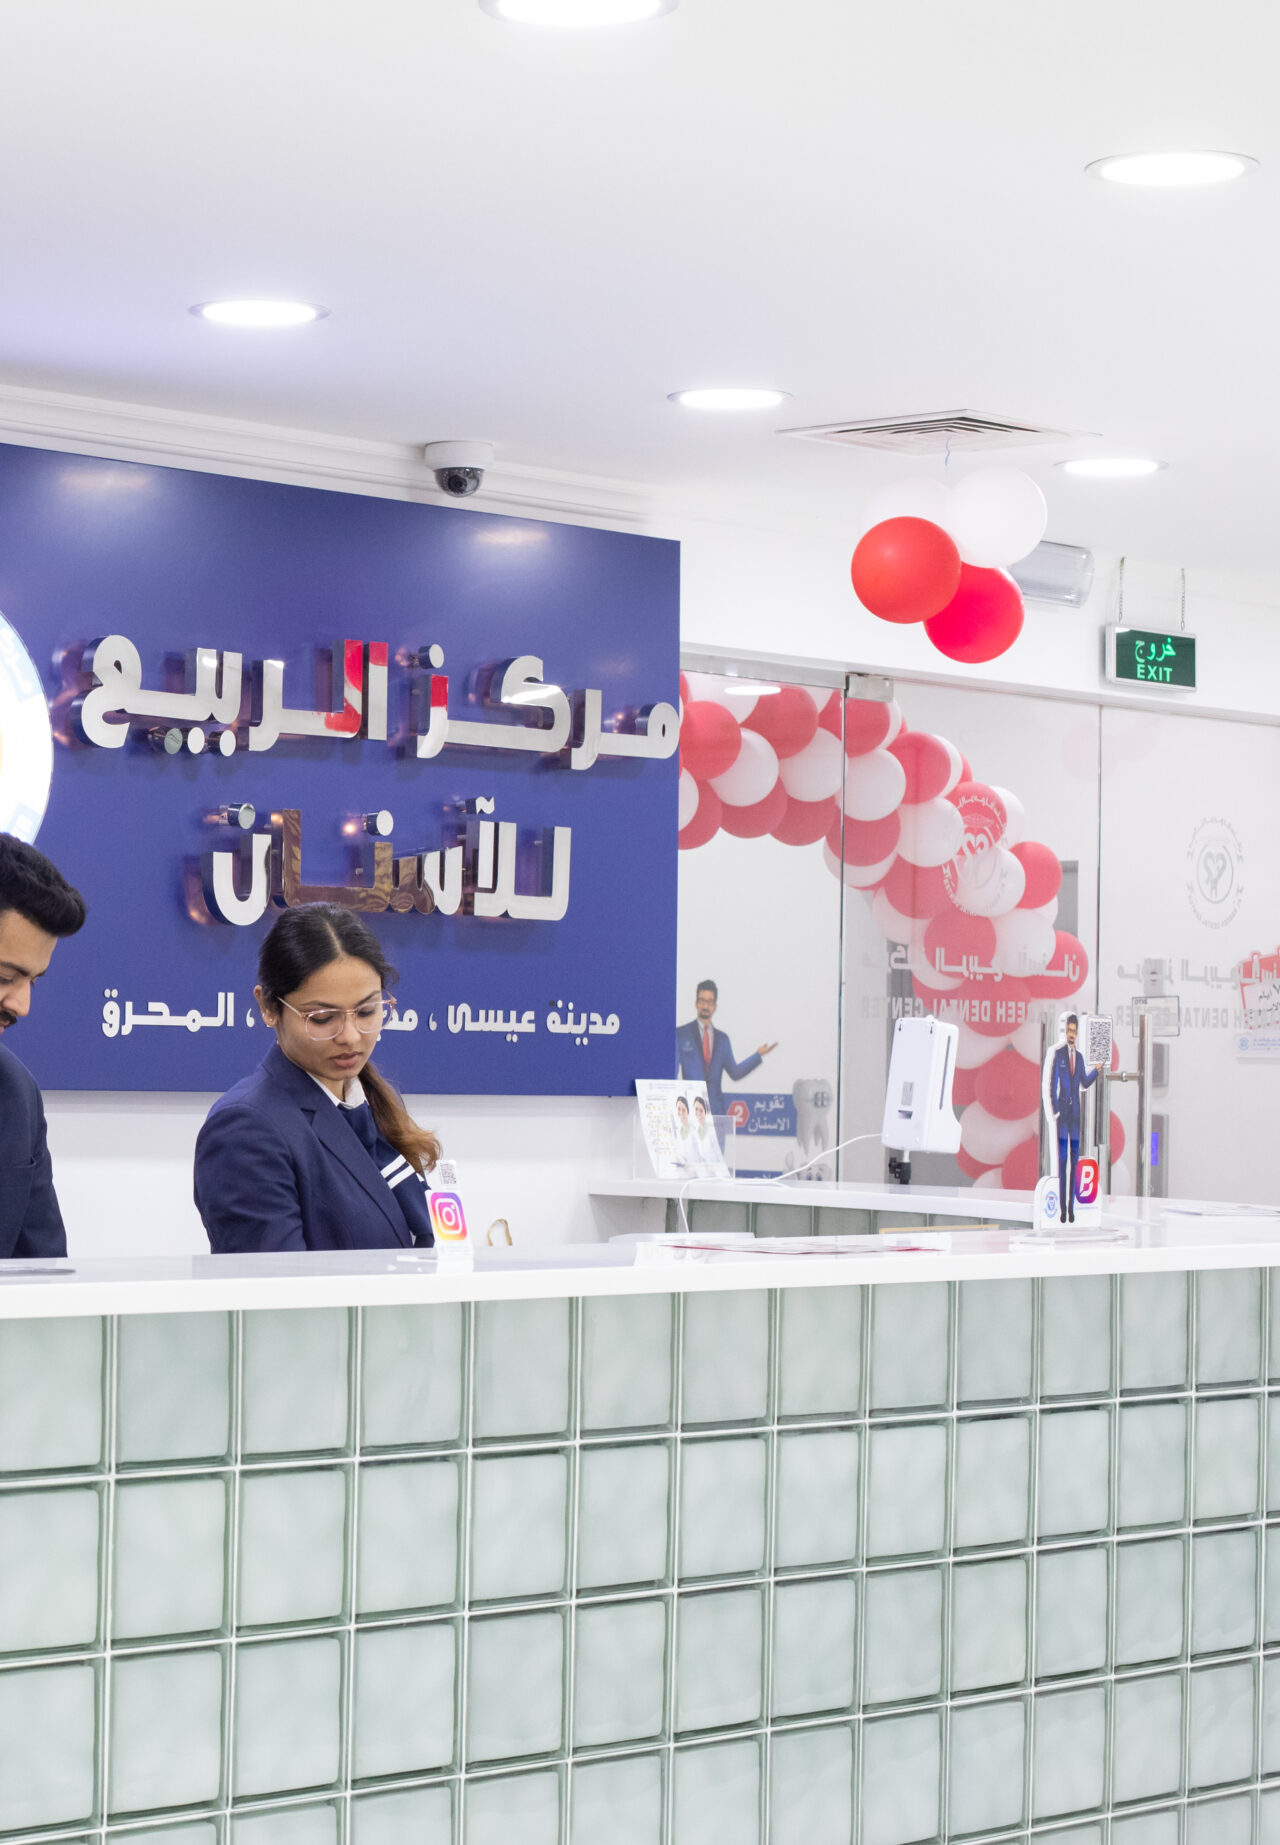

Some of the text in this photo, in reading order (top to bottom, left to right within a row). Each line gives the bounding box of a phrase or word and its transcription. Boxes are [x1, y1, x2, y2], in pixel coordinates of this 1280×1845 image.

[1134, 637, 1176, 663] خروج
[1136, 663, 1173, 682] EXIT
[78, 634, 680, 770] مركز الربيع
[102, 988, 235, 1038] المحرق
[447, 1002, 536, 1043] عيسى
[546, 999, 621, 1046] مدينة
[734, 1105, 744, 1122] 2
[753, 1095, 785, 1113] تقويم
